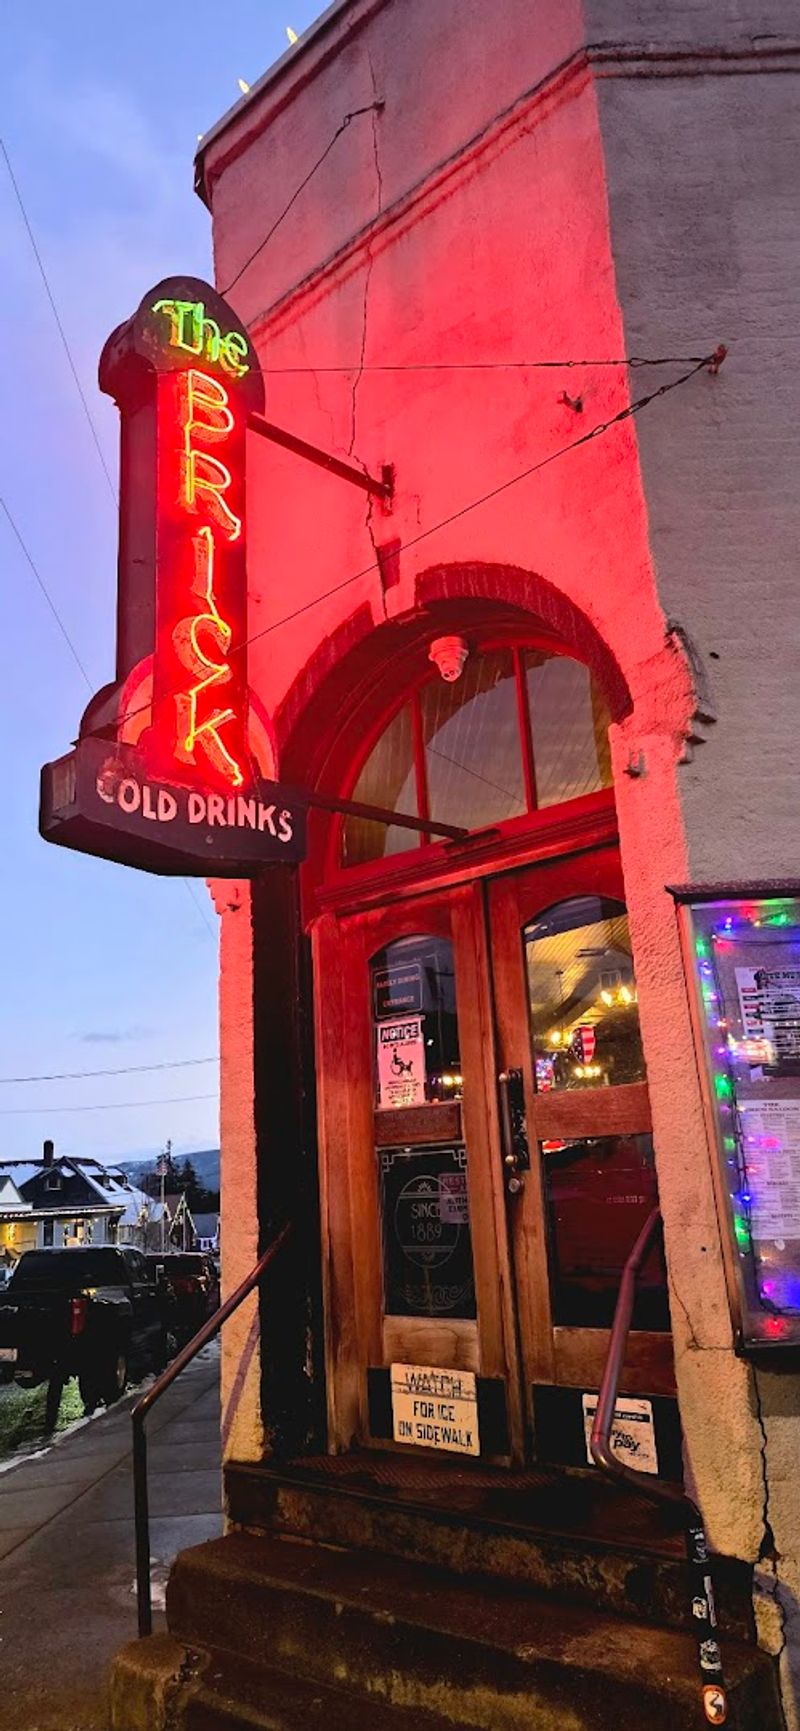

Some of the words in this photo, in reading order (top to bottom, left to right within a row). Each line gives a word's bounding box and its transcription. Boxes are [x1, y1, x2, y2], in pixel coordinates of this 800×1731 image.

[152, 299, 250, 378] The
[171, 367, 243, 788] BRICK
[96, 771, 177, 822] COLD
[188, 793, 293, 843] DRINKS
[381, 1023, 419, 1042] NOTICE
[411, 1222, 442, 1242] 1889
[405, 1372, 463, 1398] WATCH
[413, 1401, 435, 1420] FOR
[438, 1405, 456, 1422] ICE
[399, 1421, 413, 1437] ON
[416, 1423, 474, 1448] SIDEWALK
